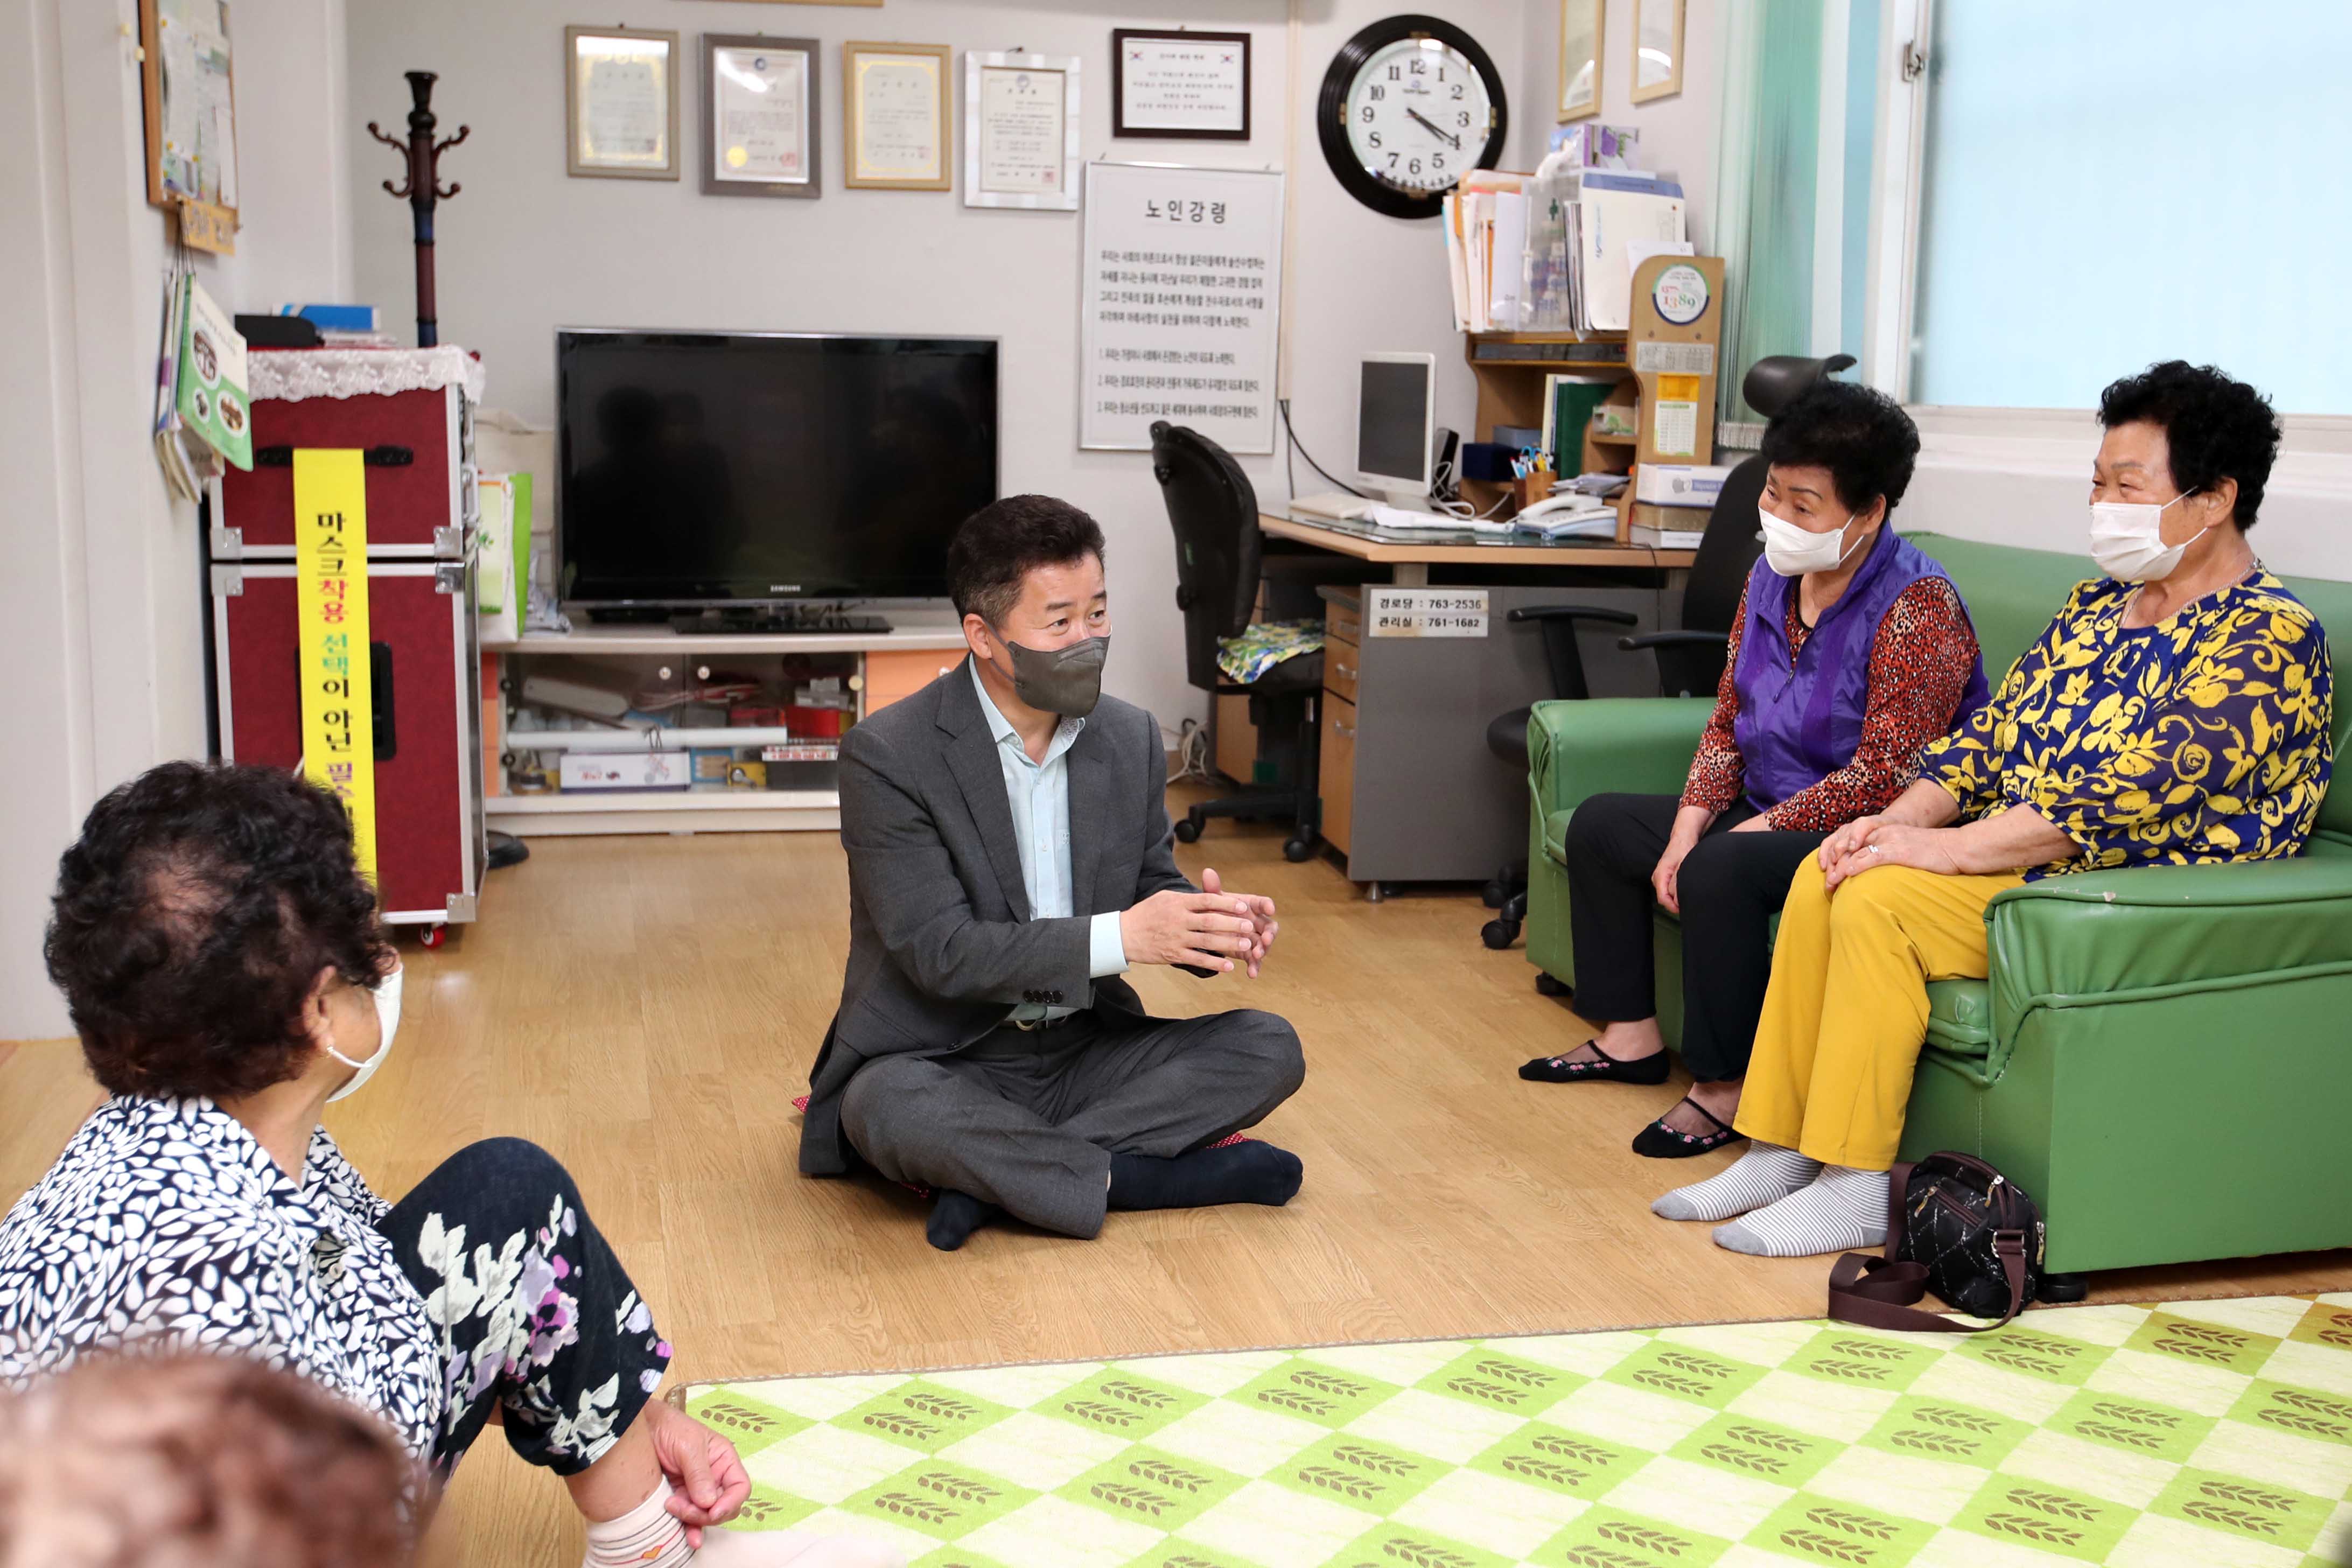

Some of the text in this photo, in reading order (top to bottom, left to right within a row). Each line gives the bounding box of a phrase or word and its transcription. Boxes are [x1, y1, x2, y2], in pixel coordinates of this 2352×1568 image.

[1389, 66, 1401, 81] 11
[1410, 59, 1426, 74] 12
[1438, 68, 1445, 81] 1
[1371, 86, 1385, 100] 10
[1451, 85, 1464, 100] 2
[1362, 107, 1374, 123] 9
[1457, 111, 1470, 127] 3
[1369, 132, 1382, 148] 8
[1447, 135, 1461, 151] 4
[1388, 152, 1400, 169] 7
[1409, 158, 1421, 174] 6
[1432, 152, 1444, 169] 5
[323, 708, 353, 752] 아닌
